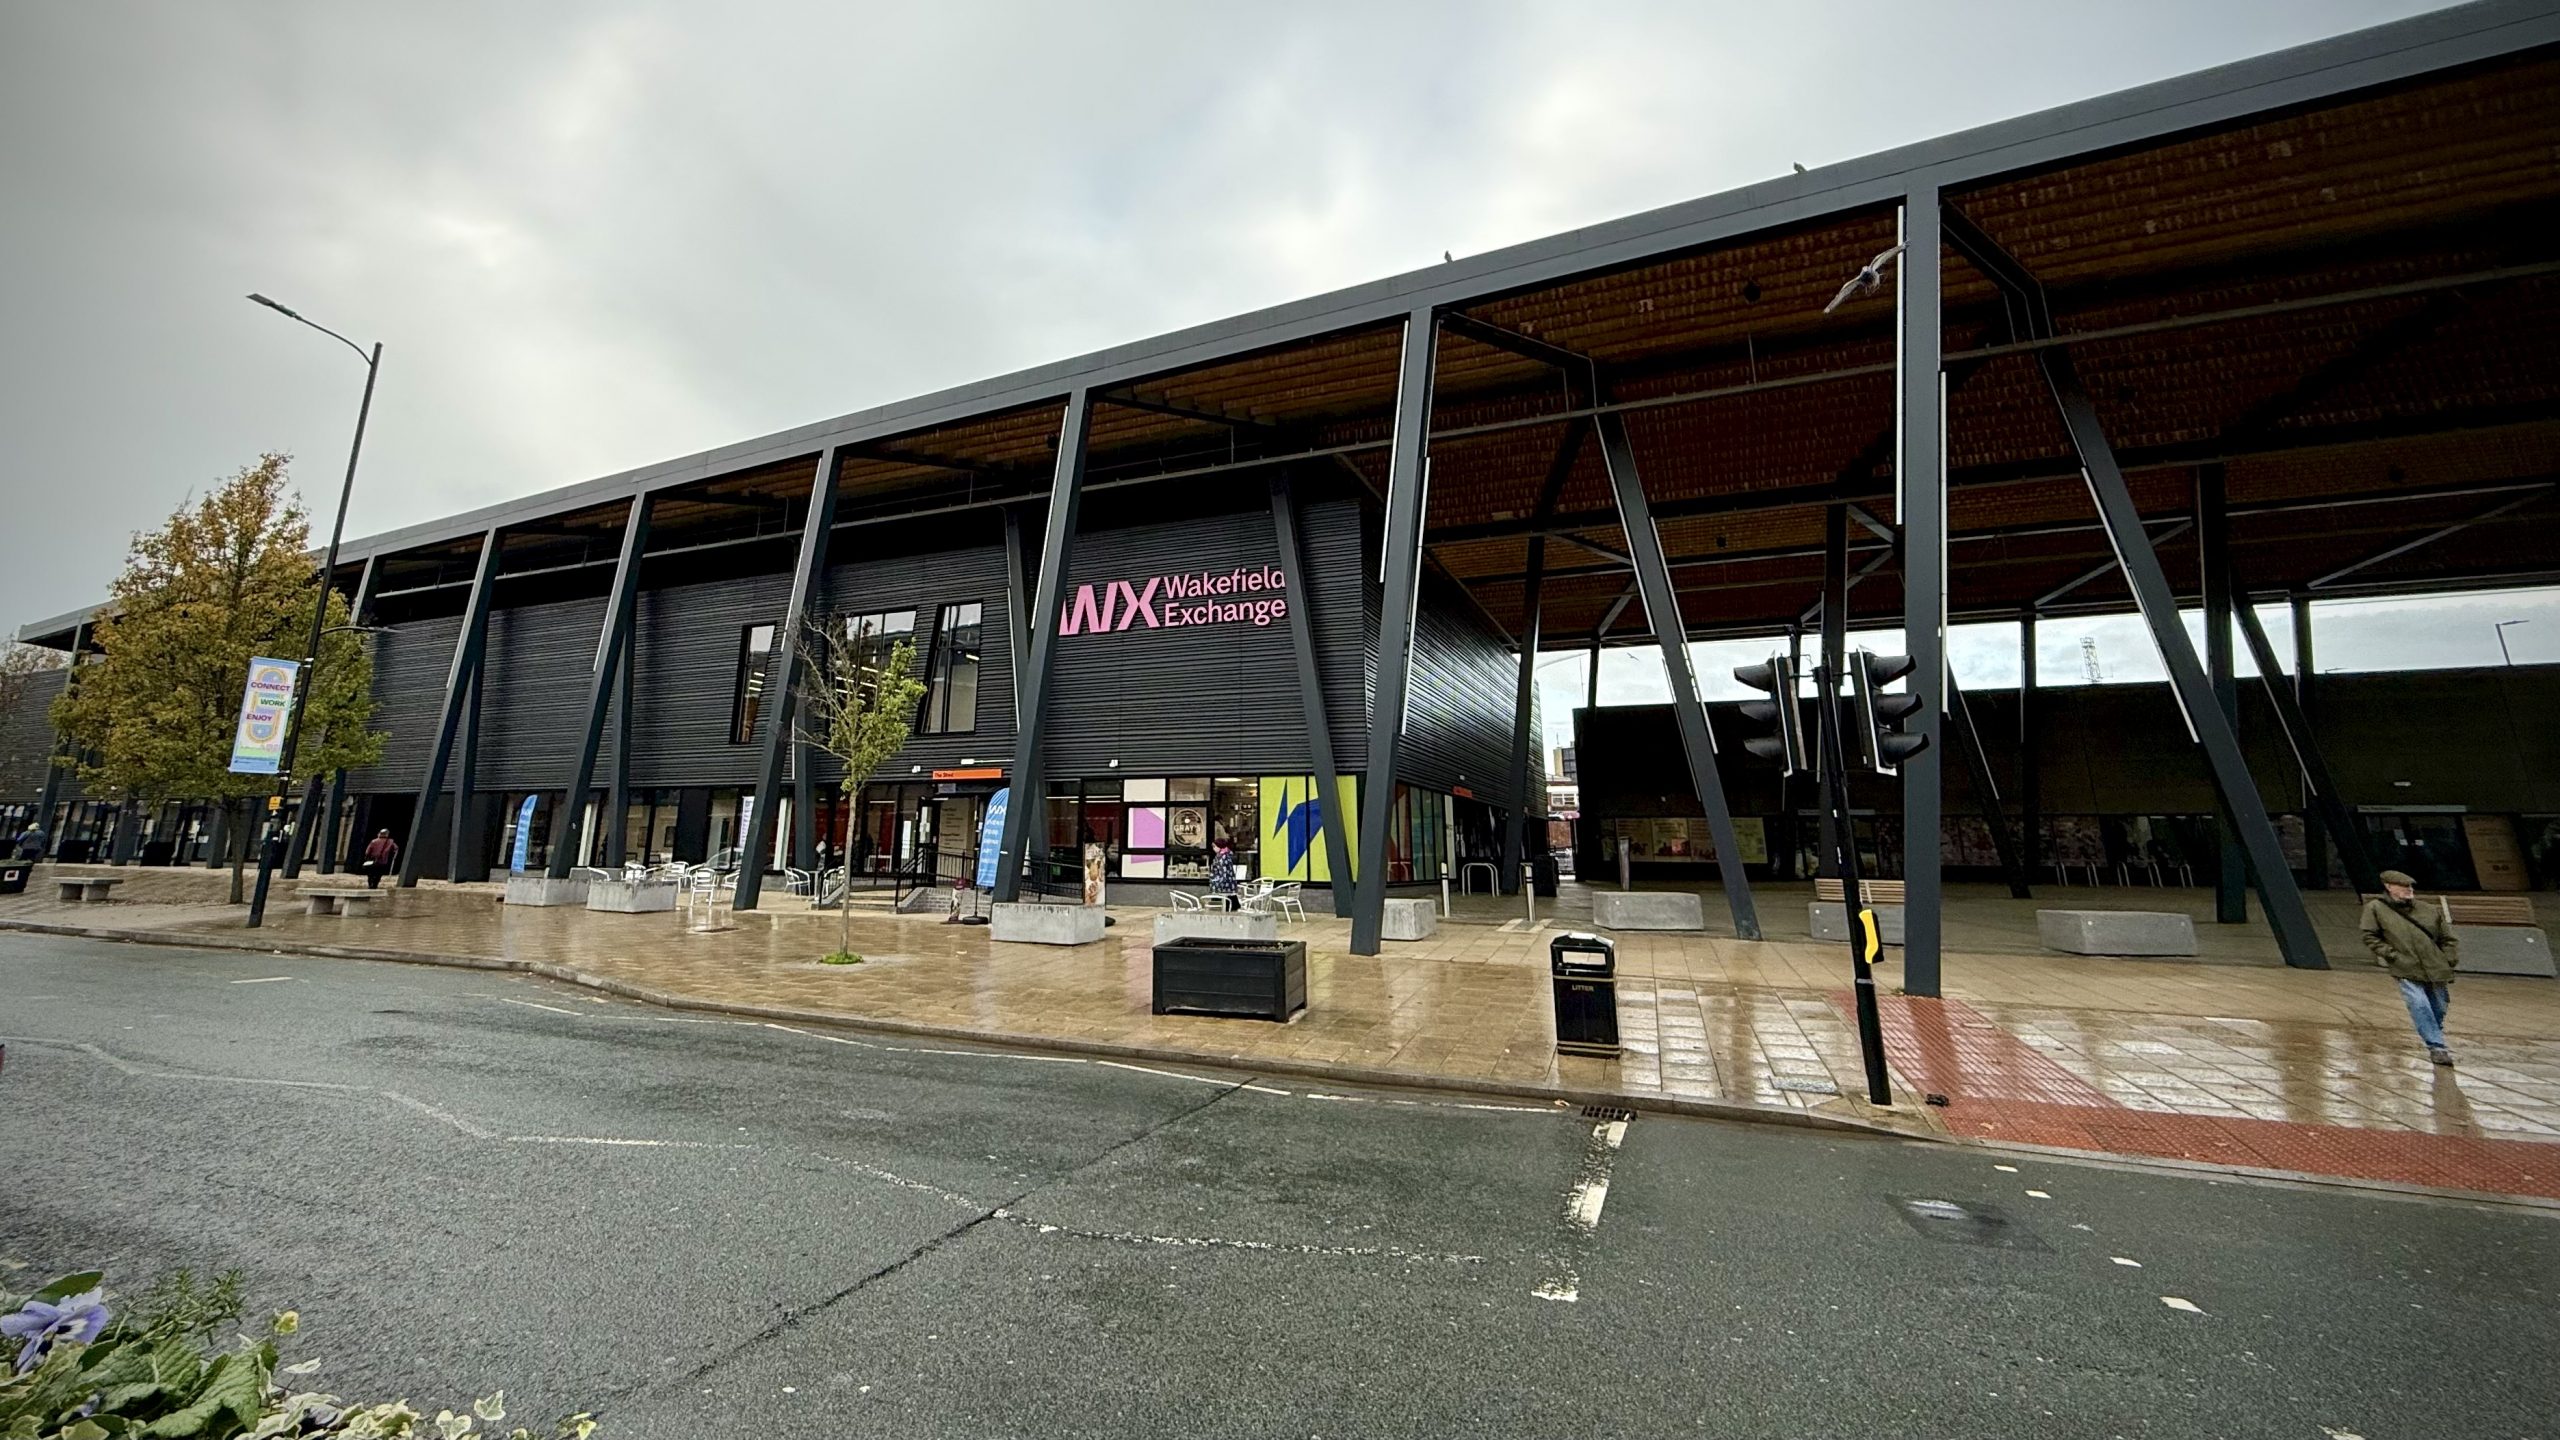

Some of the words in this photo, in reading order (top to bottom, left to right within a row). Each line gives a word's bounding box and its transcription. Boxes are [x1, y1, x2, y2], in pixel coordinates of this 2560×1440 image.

[1163, 565, 1286, 599] Wakefield
[1164, 599, 1286, 627] Exchange
[250, 681, 291, 692] CONNECT
[260, 699, 286, 707] WORK
[246, 713, 273, 722] ENJOY
[1571, 984, 1594, 992] LITTER
